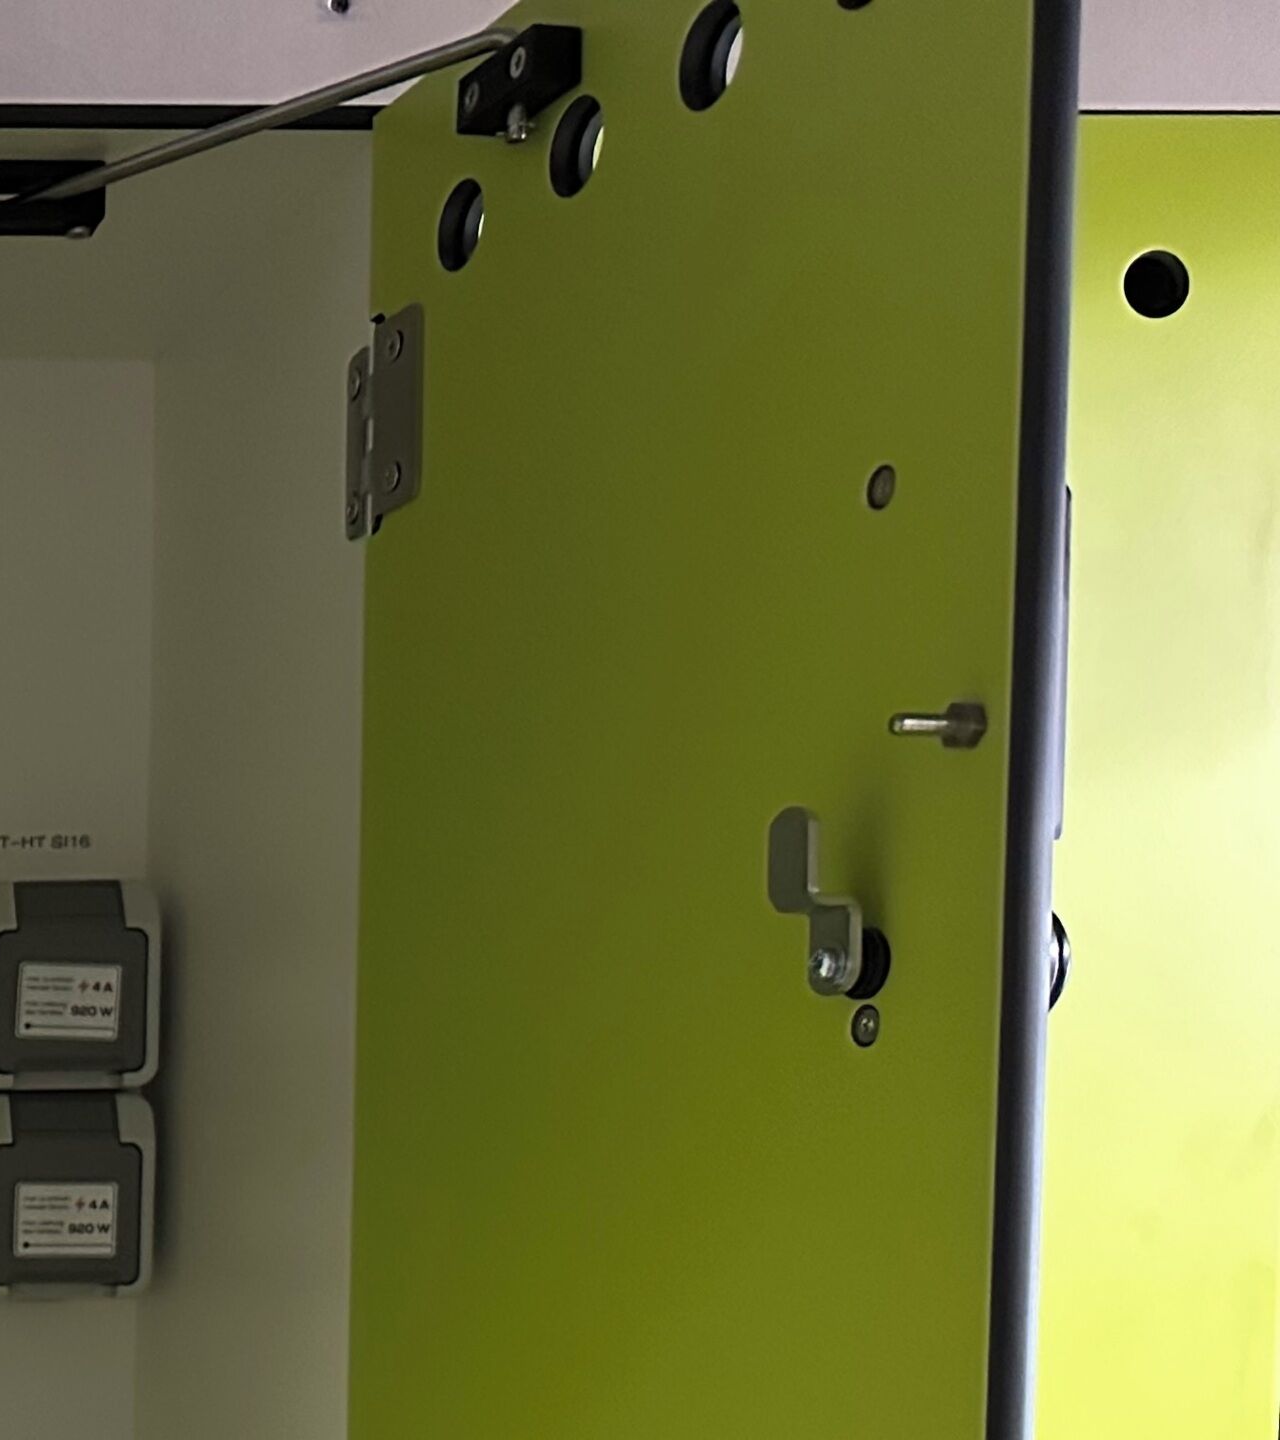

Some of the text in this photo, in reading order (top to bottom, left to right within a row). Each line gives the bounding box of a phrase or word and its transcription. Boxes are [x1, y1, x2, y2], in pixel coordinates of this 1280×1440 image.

[92, 981, 113, 993] 4 A
[99, 1006, 113, 1017] W
[88, 1199, 110, 1210] 4 A
[96, 1223, 110, 1234] W
